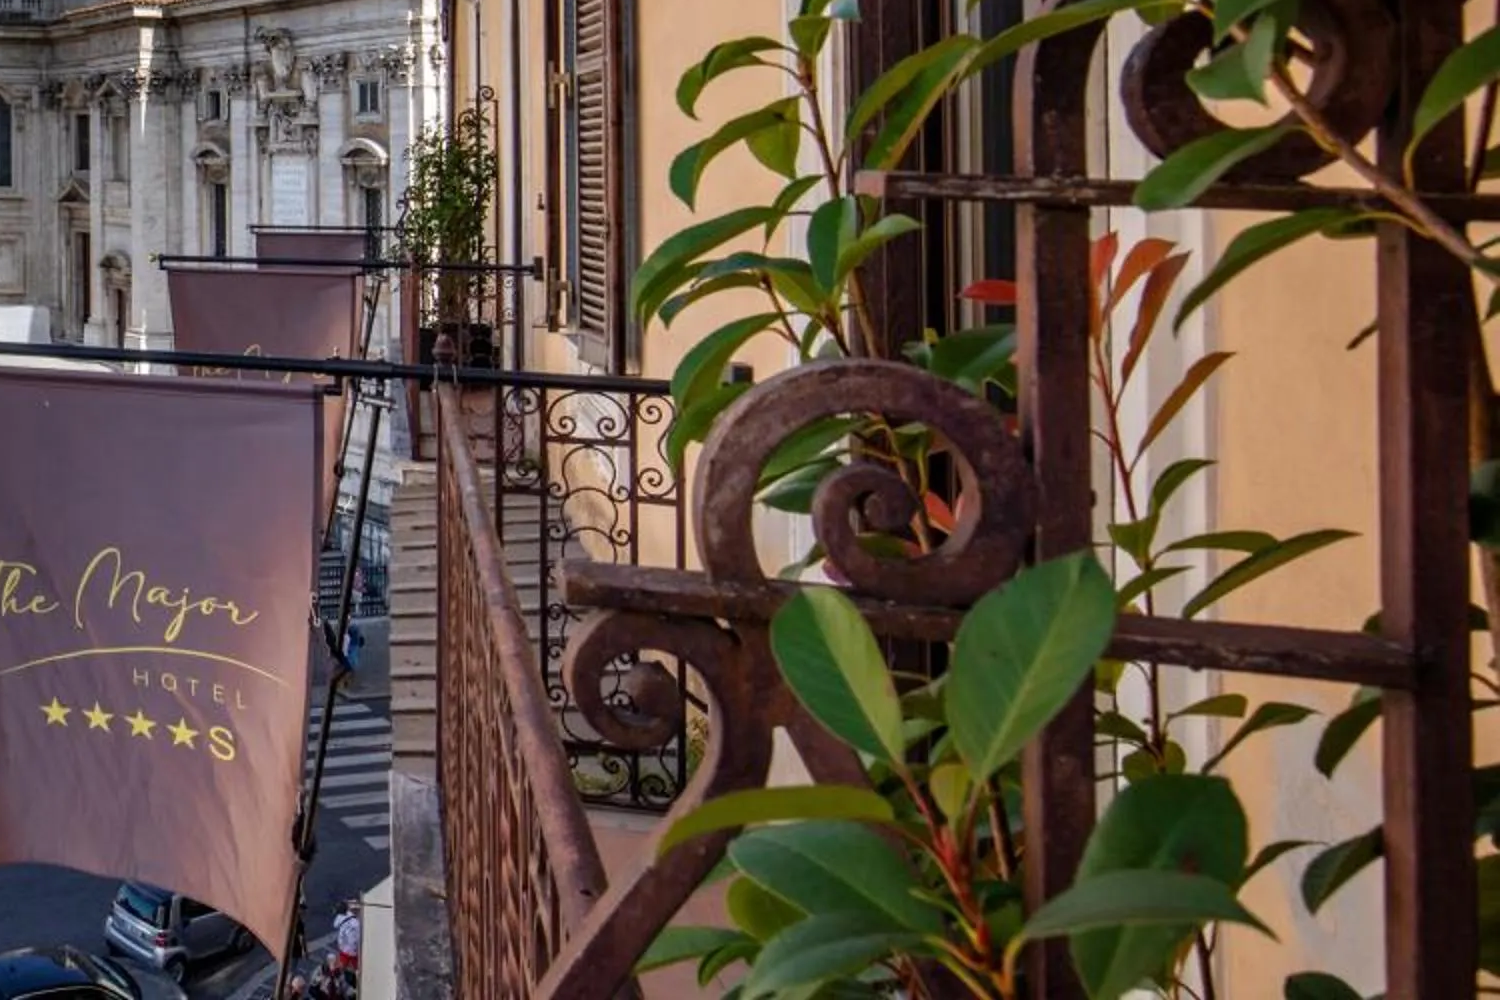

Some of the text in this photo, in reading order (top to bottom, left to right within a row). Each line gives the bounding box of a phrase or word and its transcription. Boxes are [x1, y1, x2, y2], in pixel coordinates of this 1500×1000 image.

[75, 547, 258, 642] Major
[131, 667, 248, 711] HOTEL
[208, 727, 235, 761] S
